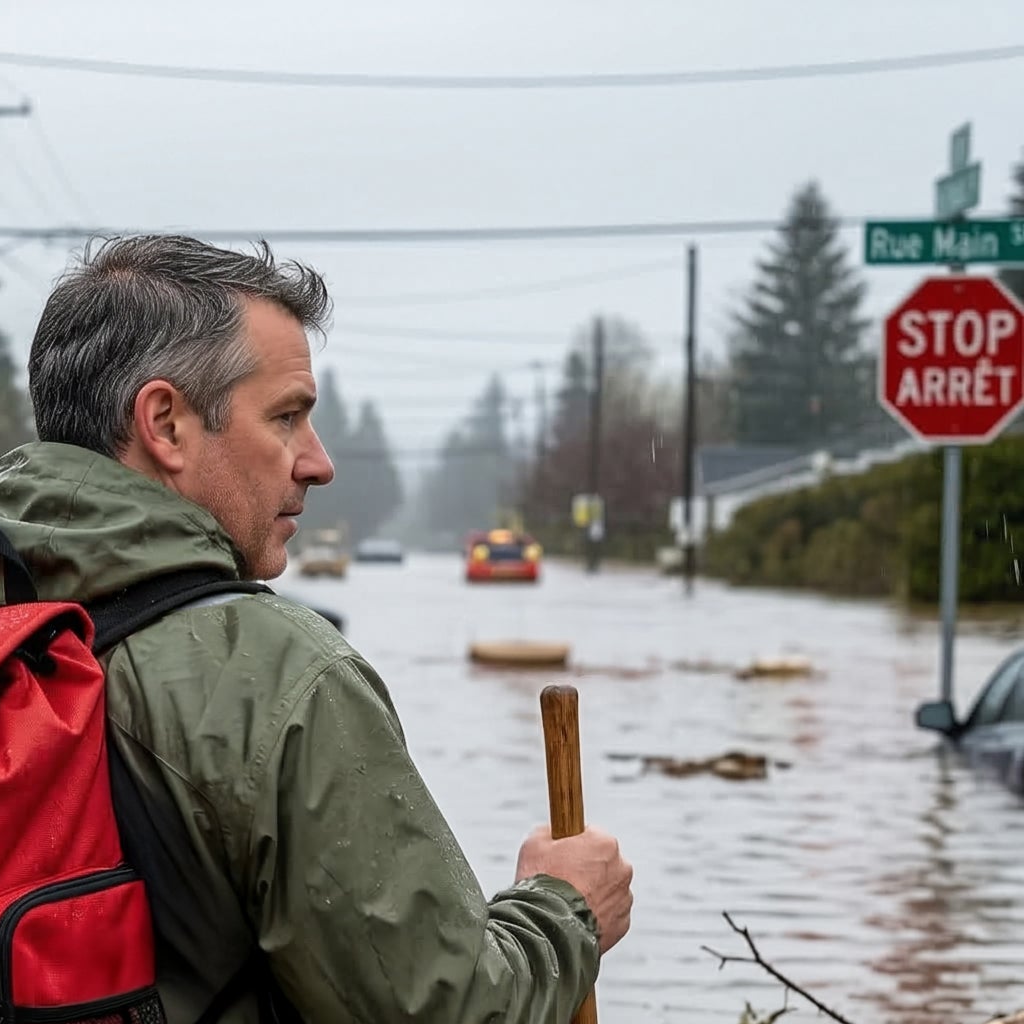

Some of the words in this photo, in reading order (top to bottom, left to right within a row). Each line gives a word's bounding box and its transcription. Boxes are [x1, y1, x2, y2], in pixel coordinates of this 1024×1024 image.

[870, 226, 923, 260] Rue
[932, 224, 999, 259] Main
[897, 309, 1016, 358] STOP
[895, 357, 1016, 407] ARRÊT
